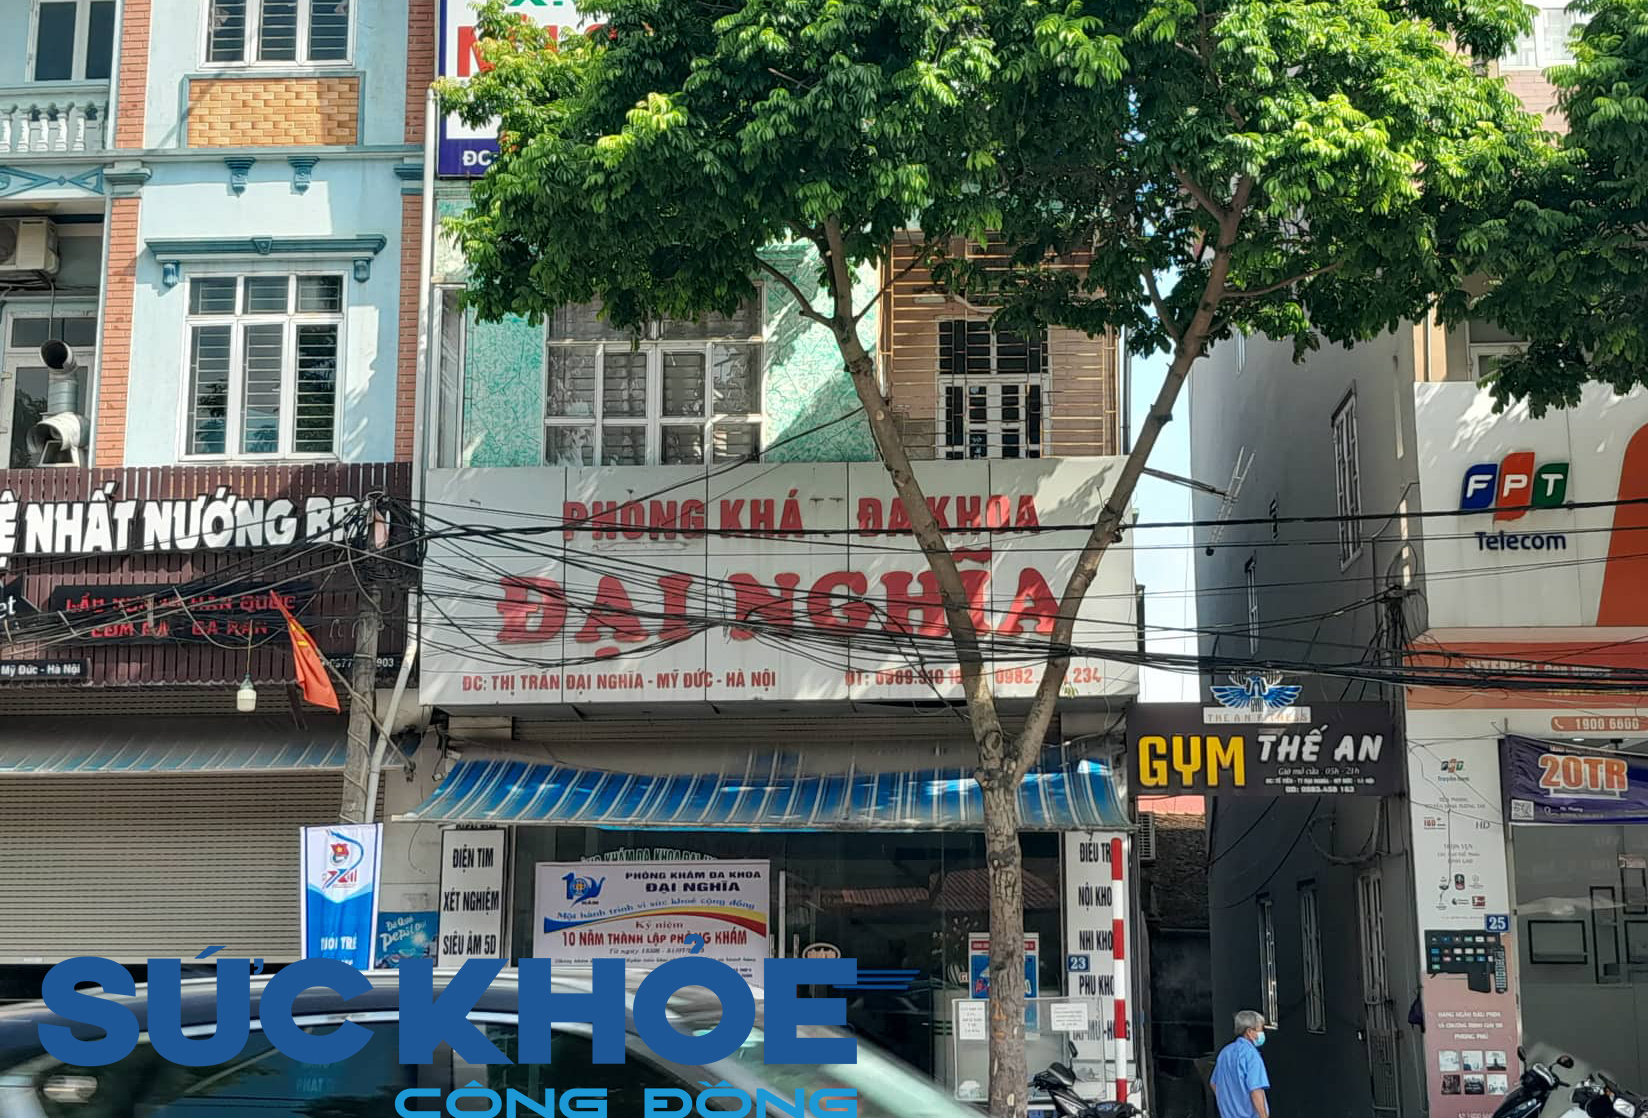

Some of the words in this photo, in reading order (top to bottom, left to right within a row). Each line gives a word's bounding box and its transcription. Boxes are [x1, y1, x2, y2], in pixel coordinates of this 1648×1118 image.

[26, 482, 137, 554] NHẤT
[144, 487, 298, 550] NƯỚNG
[1475, 531, 1566, 550] Telecom
[496, 574, 695, 660] ĐẠI
[18, 663, 38, 675] Đức
[47, 664, 61, 674] Hà
[63, 663, 80, 675] Nội
[462, 676, 488, 691] ĐC:
[491, 675, 516, 696] THỊ
[520, 669, 560, 691] TRẤN
[566, 675, 592, 695] ĐẠI
[597, 671, 643, 691] NGHĨA
[657, 669, 679, 689] MỸ
[683, 668, 713, 688] ĐỨC
[726, 668, 745, 688] HÀ
[751, 668, 776, 691] NỘI
[1576, 718, 1605, 730] 1900
[1139, 735, 1245, 787] GYM
[1258, 724, 1328, 762] THẾ
[1334, 735, 1383, 761] AN
[1540, 754, 1627, 790] 20TR
[452, 844, 474, 873] ĐIỆN
[477, 847, 494, 868] TIM
[1101, 842, 1112, 862] TR
[645, 882, 676, 894] ĐẠI
[683, 880, 741, 892] NGHĨA
[1079, 882, 1093, 911] NỘI
[1096, 886, 1112, 907] KHO
[443, 887, 460, 912] XÉT
[463, 886, 500, 916] NGHIỆM
[1489, 917, 1506, 930] 25
[443, 930, 464, 955] SIÊU
[466, 930, 482, 955] ÂM
[484, 934, 497, 955] 5D
[562, 932, 576, 946] 10
[579, 929, 604, 946] NĂM
[608, 931, 643, 944] THÀNH
[647, 932, 667, 946] LẬP
[715, 927, 747, 944] KHÁM
[1079, 930, 1094, 950] NHI
[1096, 930, 1113, 950] KHO
[1070, 956, 1087, 970] 23
[1098, 975, 1114, 996] KHO
